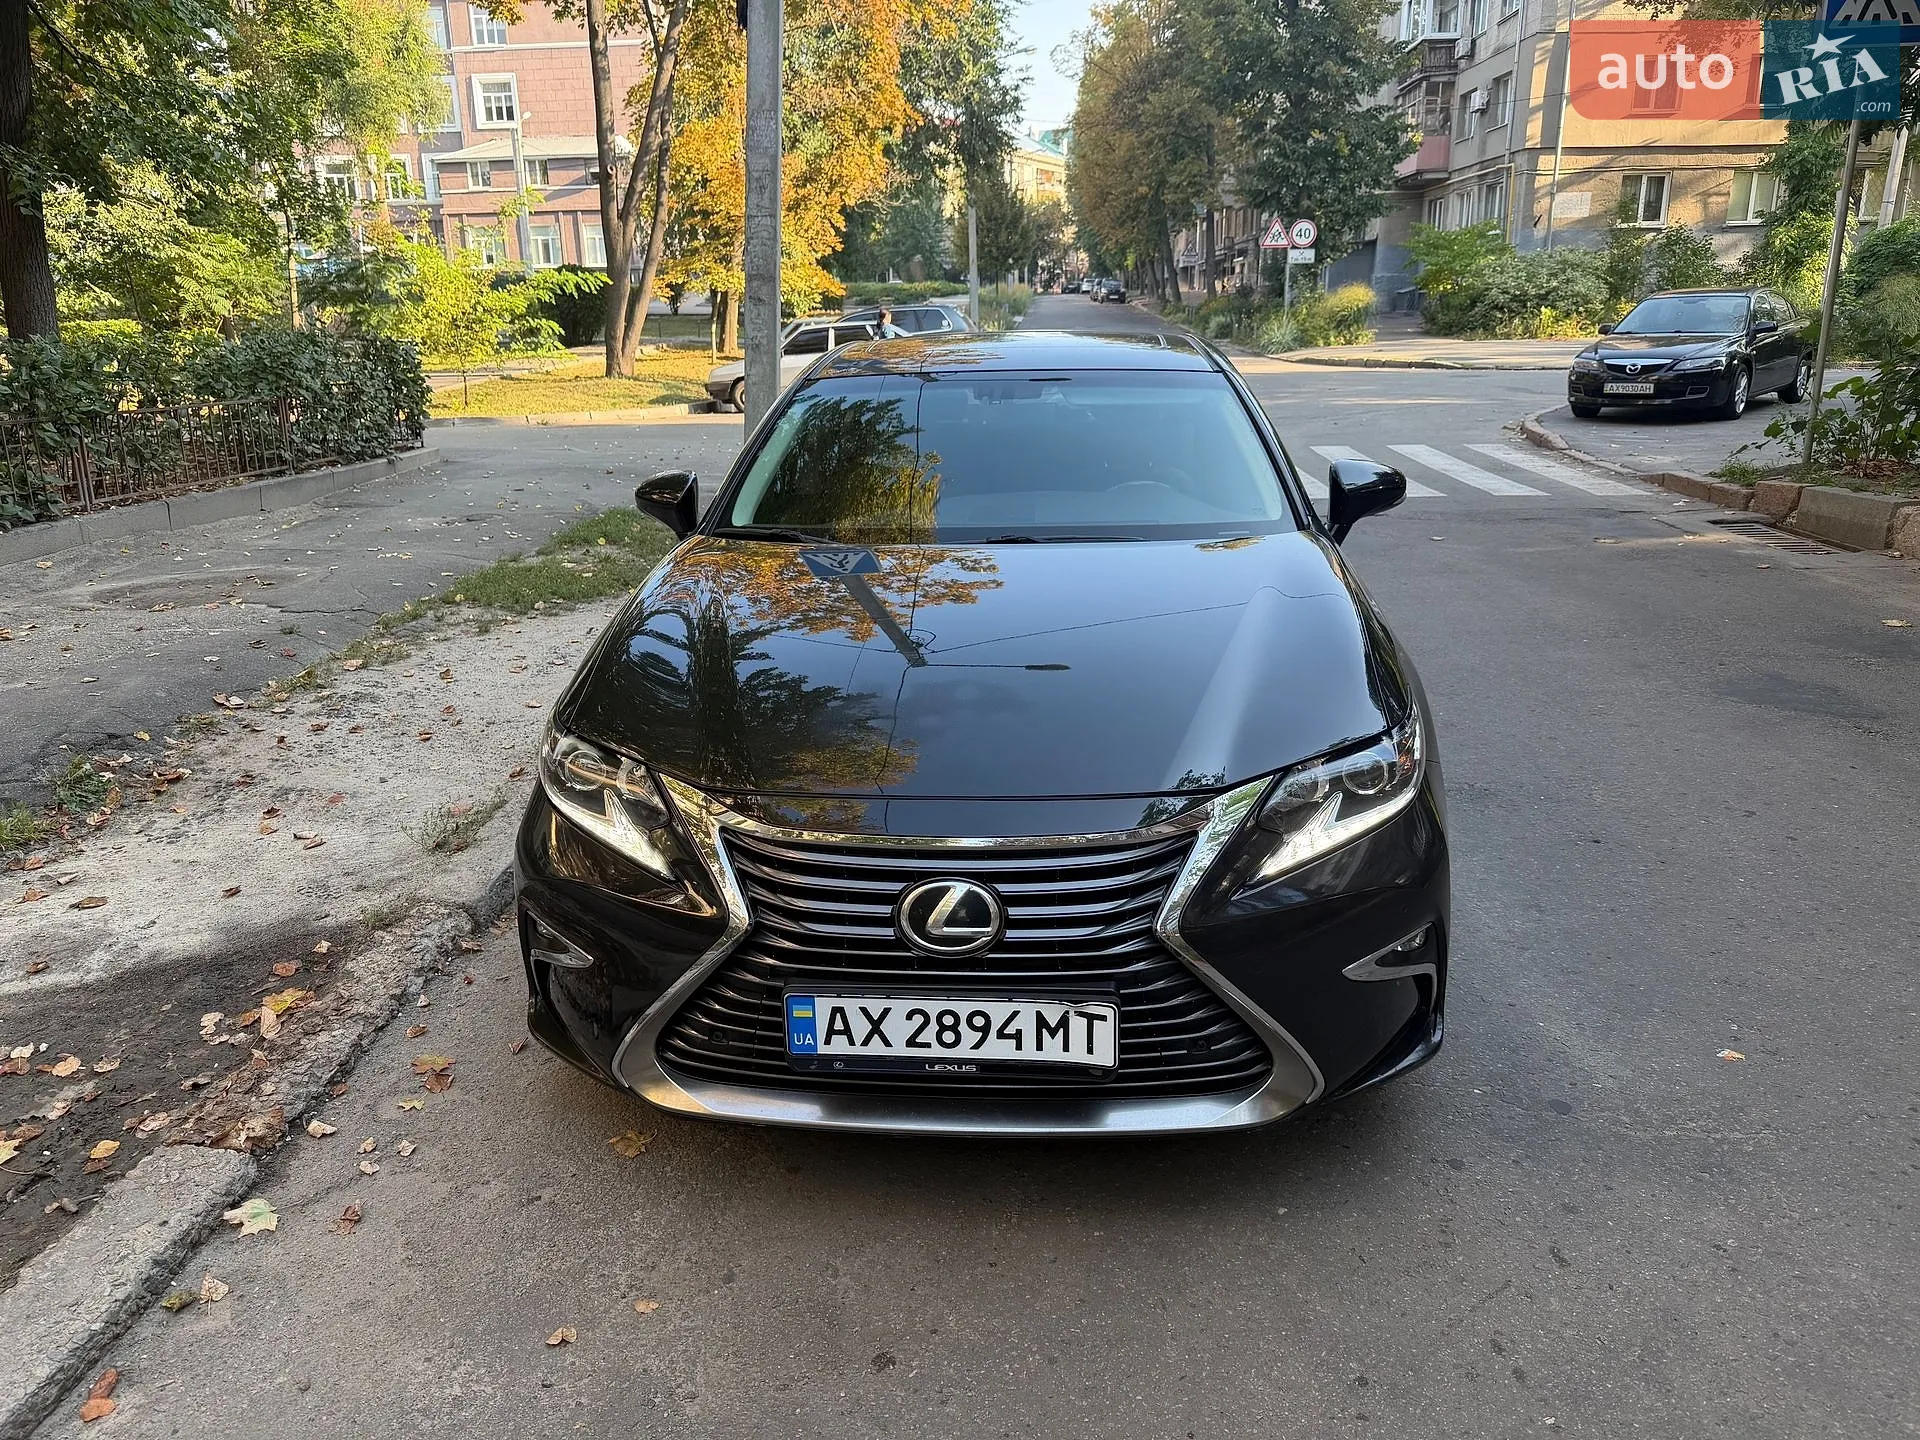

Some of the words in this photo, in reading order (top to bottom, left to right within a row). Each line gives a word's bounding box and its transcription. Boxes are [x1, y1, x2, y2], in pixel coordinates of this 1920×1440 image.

[1295, 228, 1311, 240] 40
[794, 1033, 815, 1046] UA
[925, 1063, 977, 1072] LEXUS
